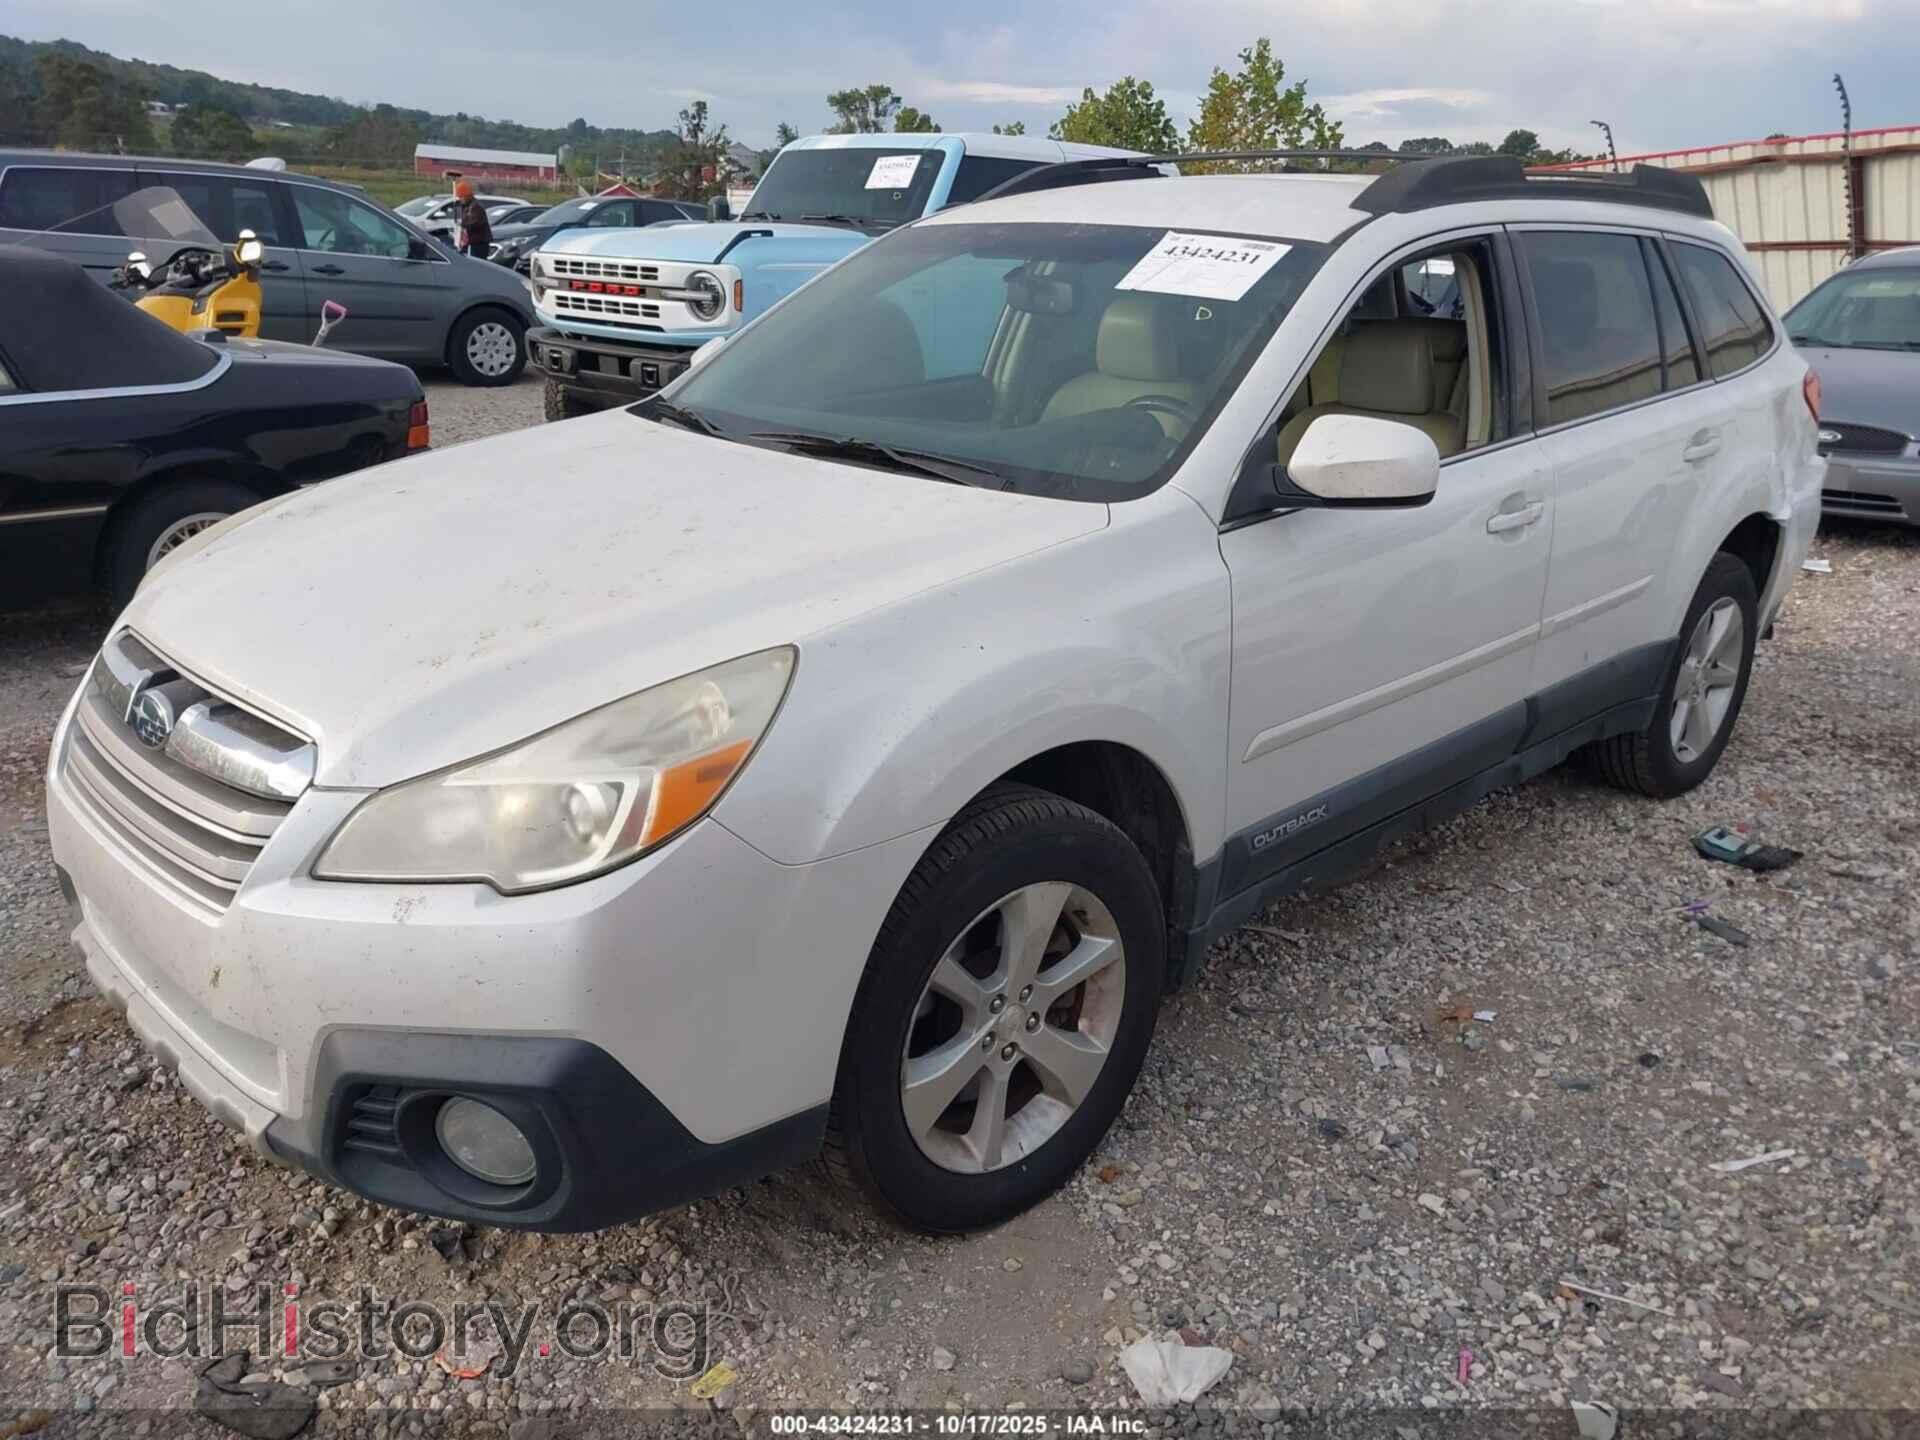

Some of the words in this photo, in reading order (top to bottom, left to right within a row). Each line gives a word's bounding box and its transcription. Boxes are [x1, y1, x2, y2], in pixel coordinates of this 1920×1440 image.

[1163, 245, 1261, 265] 43424231
[571, 281, 640, 297] FORD
[1254, 803, 1328, 849] OUTBACK
